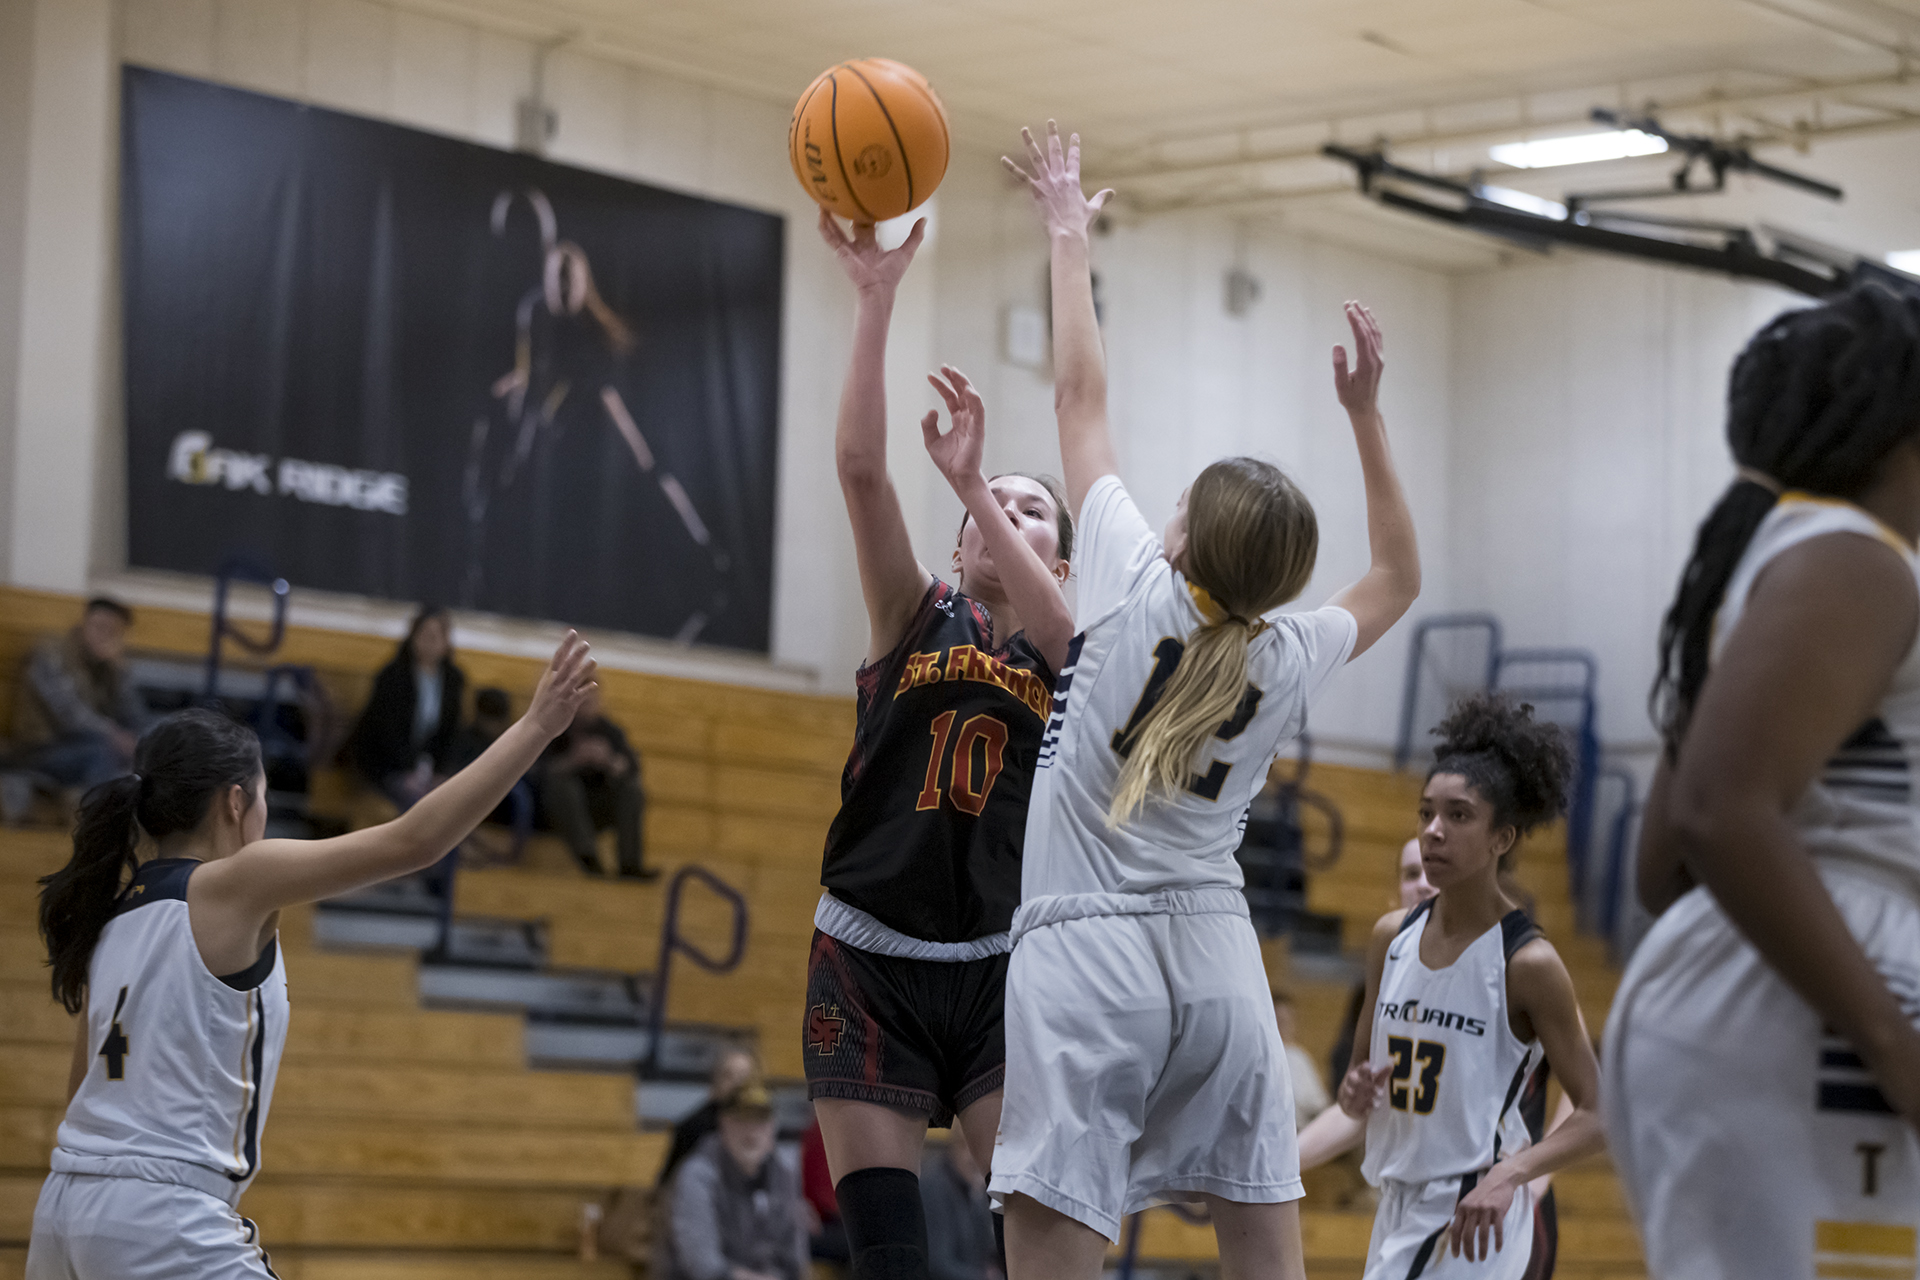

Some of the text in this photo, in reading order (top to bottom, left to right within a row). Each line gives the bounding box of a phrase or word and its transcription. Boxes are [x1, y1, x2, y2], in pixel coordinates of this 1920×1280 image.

[278, 457, 409, 515] RIDGE
[915, 710, 1008, 817] 10
[98, 984, 129, 1081] 4
[1379, 999, 1487, 1037] TROJANS
[1387, 1034, 1446, 1117] 23
[1855, 1141, 1886, 1197] T
